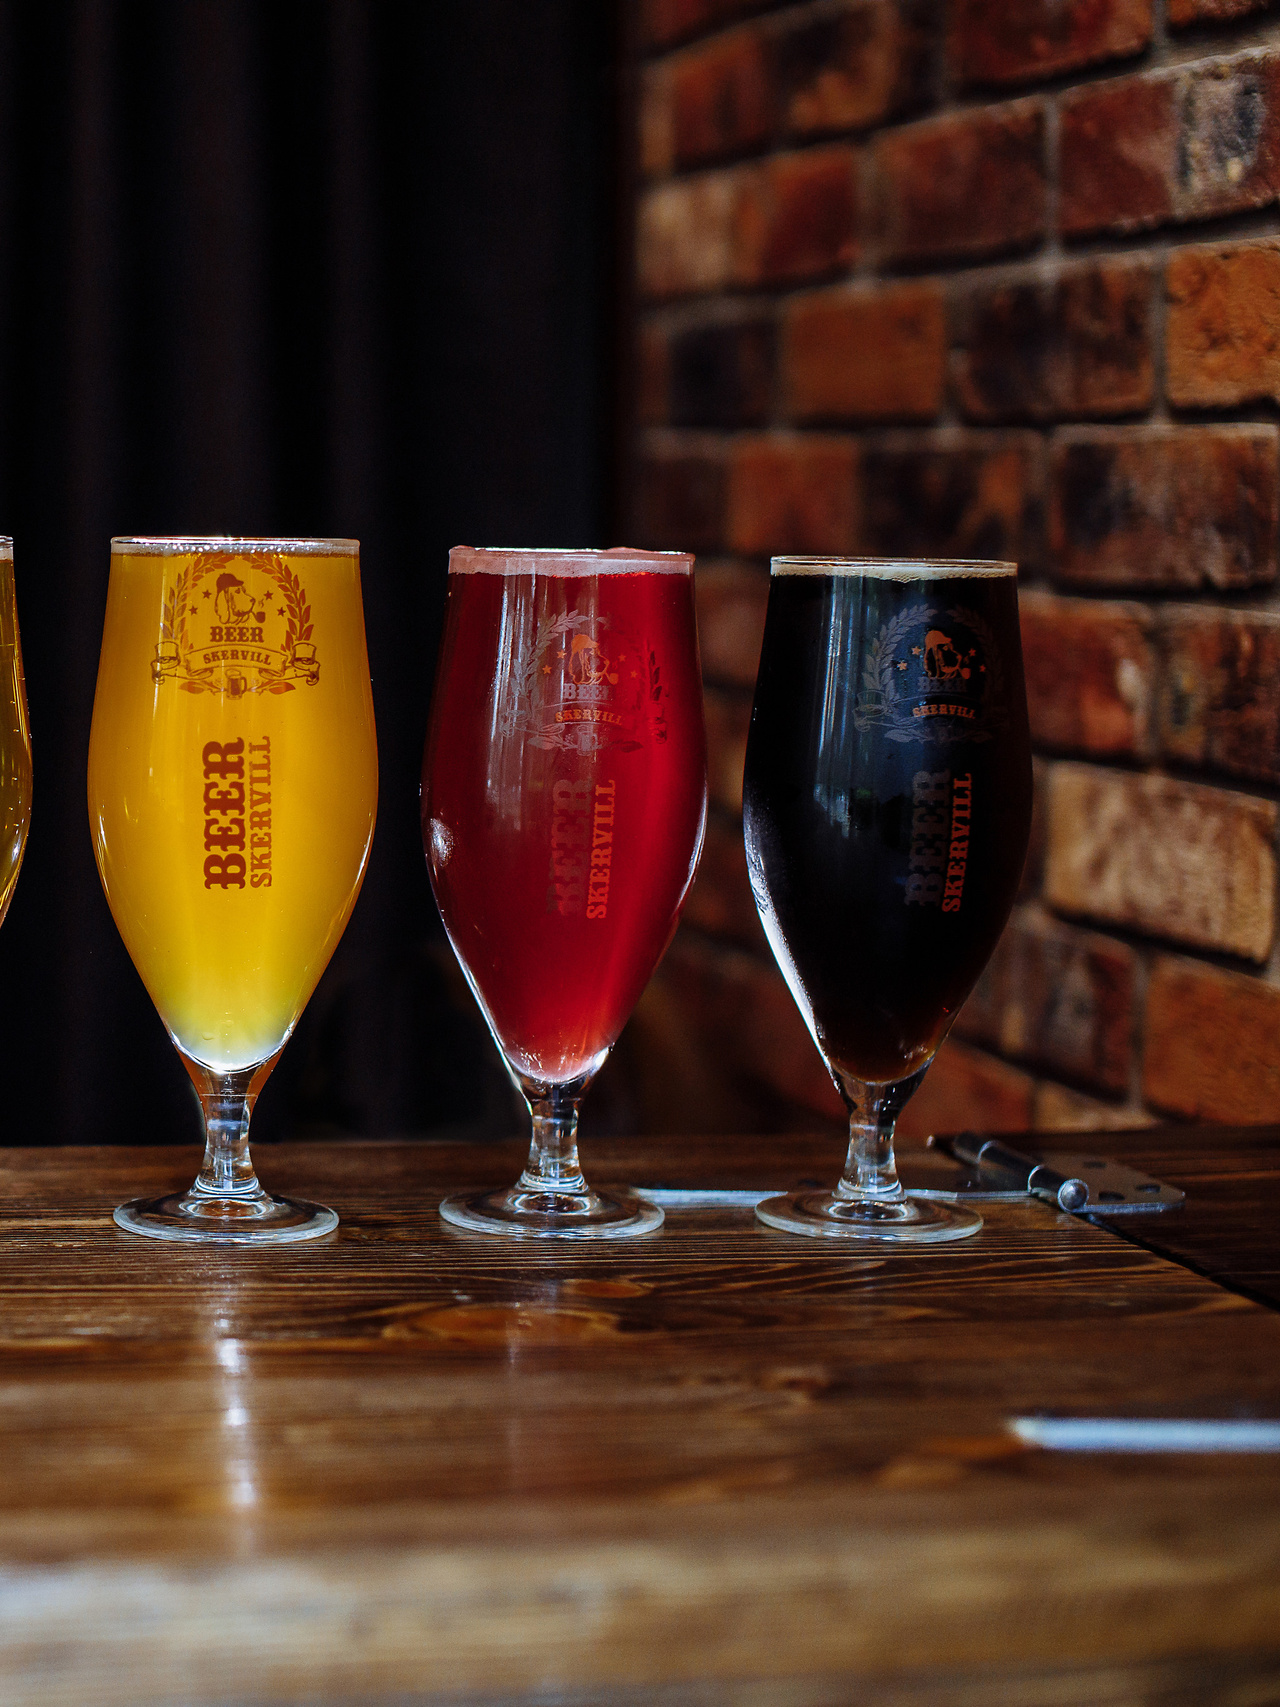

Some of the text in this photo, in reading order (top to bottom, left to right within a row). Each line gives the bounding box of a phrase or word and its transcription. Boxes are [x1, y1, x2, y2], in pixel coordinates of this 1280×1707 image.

[203, 649, 271, 665] SKERVILL
[210, 626, 264, 642] BEER
[555, 709, 622, 725] SKERVILL
[913, 704, 976, 719] SKERVILL
[203, 737, 247, 890] BEER
[250, 736, 273, 888] SKERVILL
[547, 779, 593, 917] BEER
[586, 779, 616, 919] SKERVILL
[905, 768, 952, 907] BEER
[942, 773, 973, 913] SKERVILL
